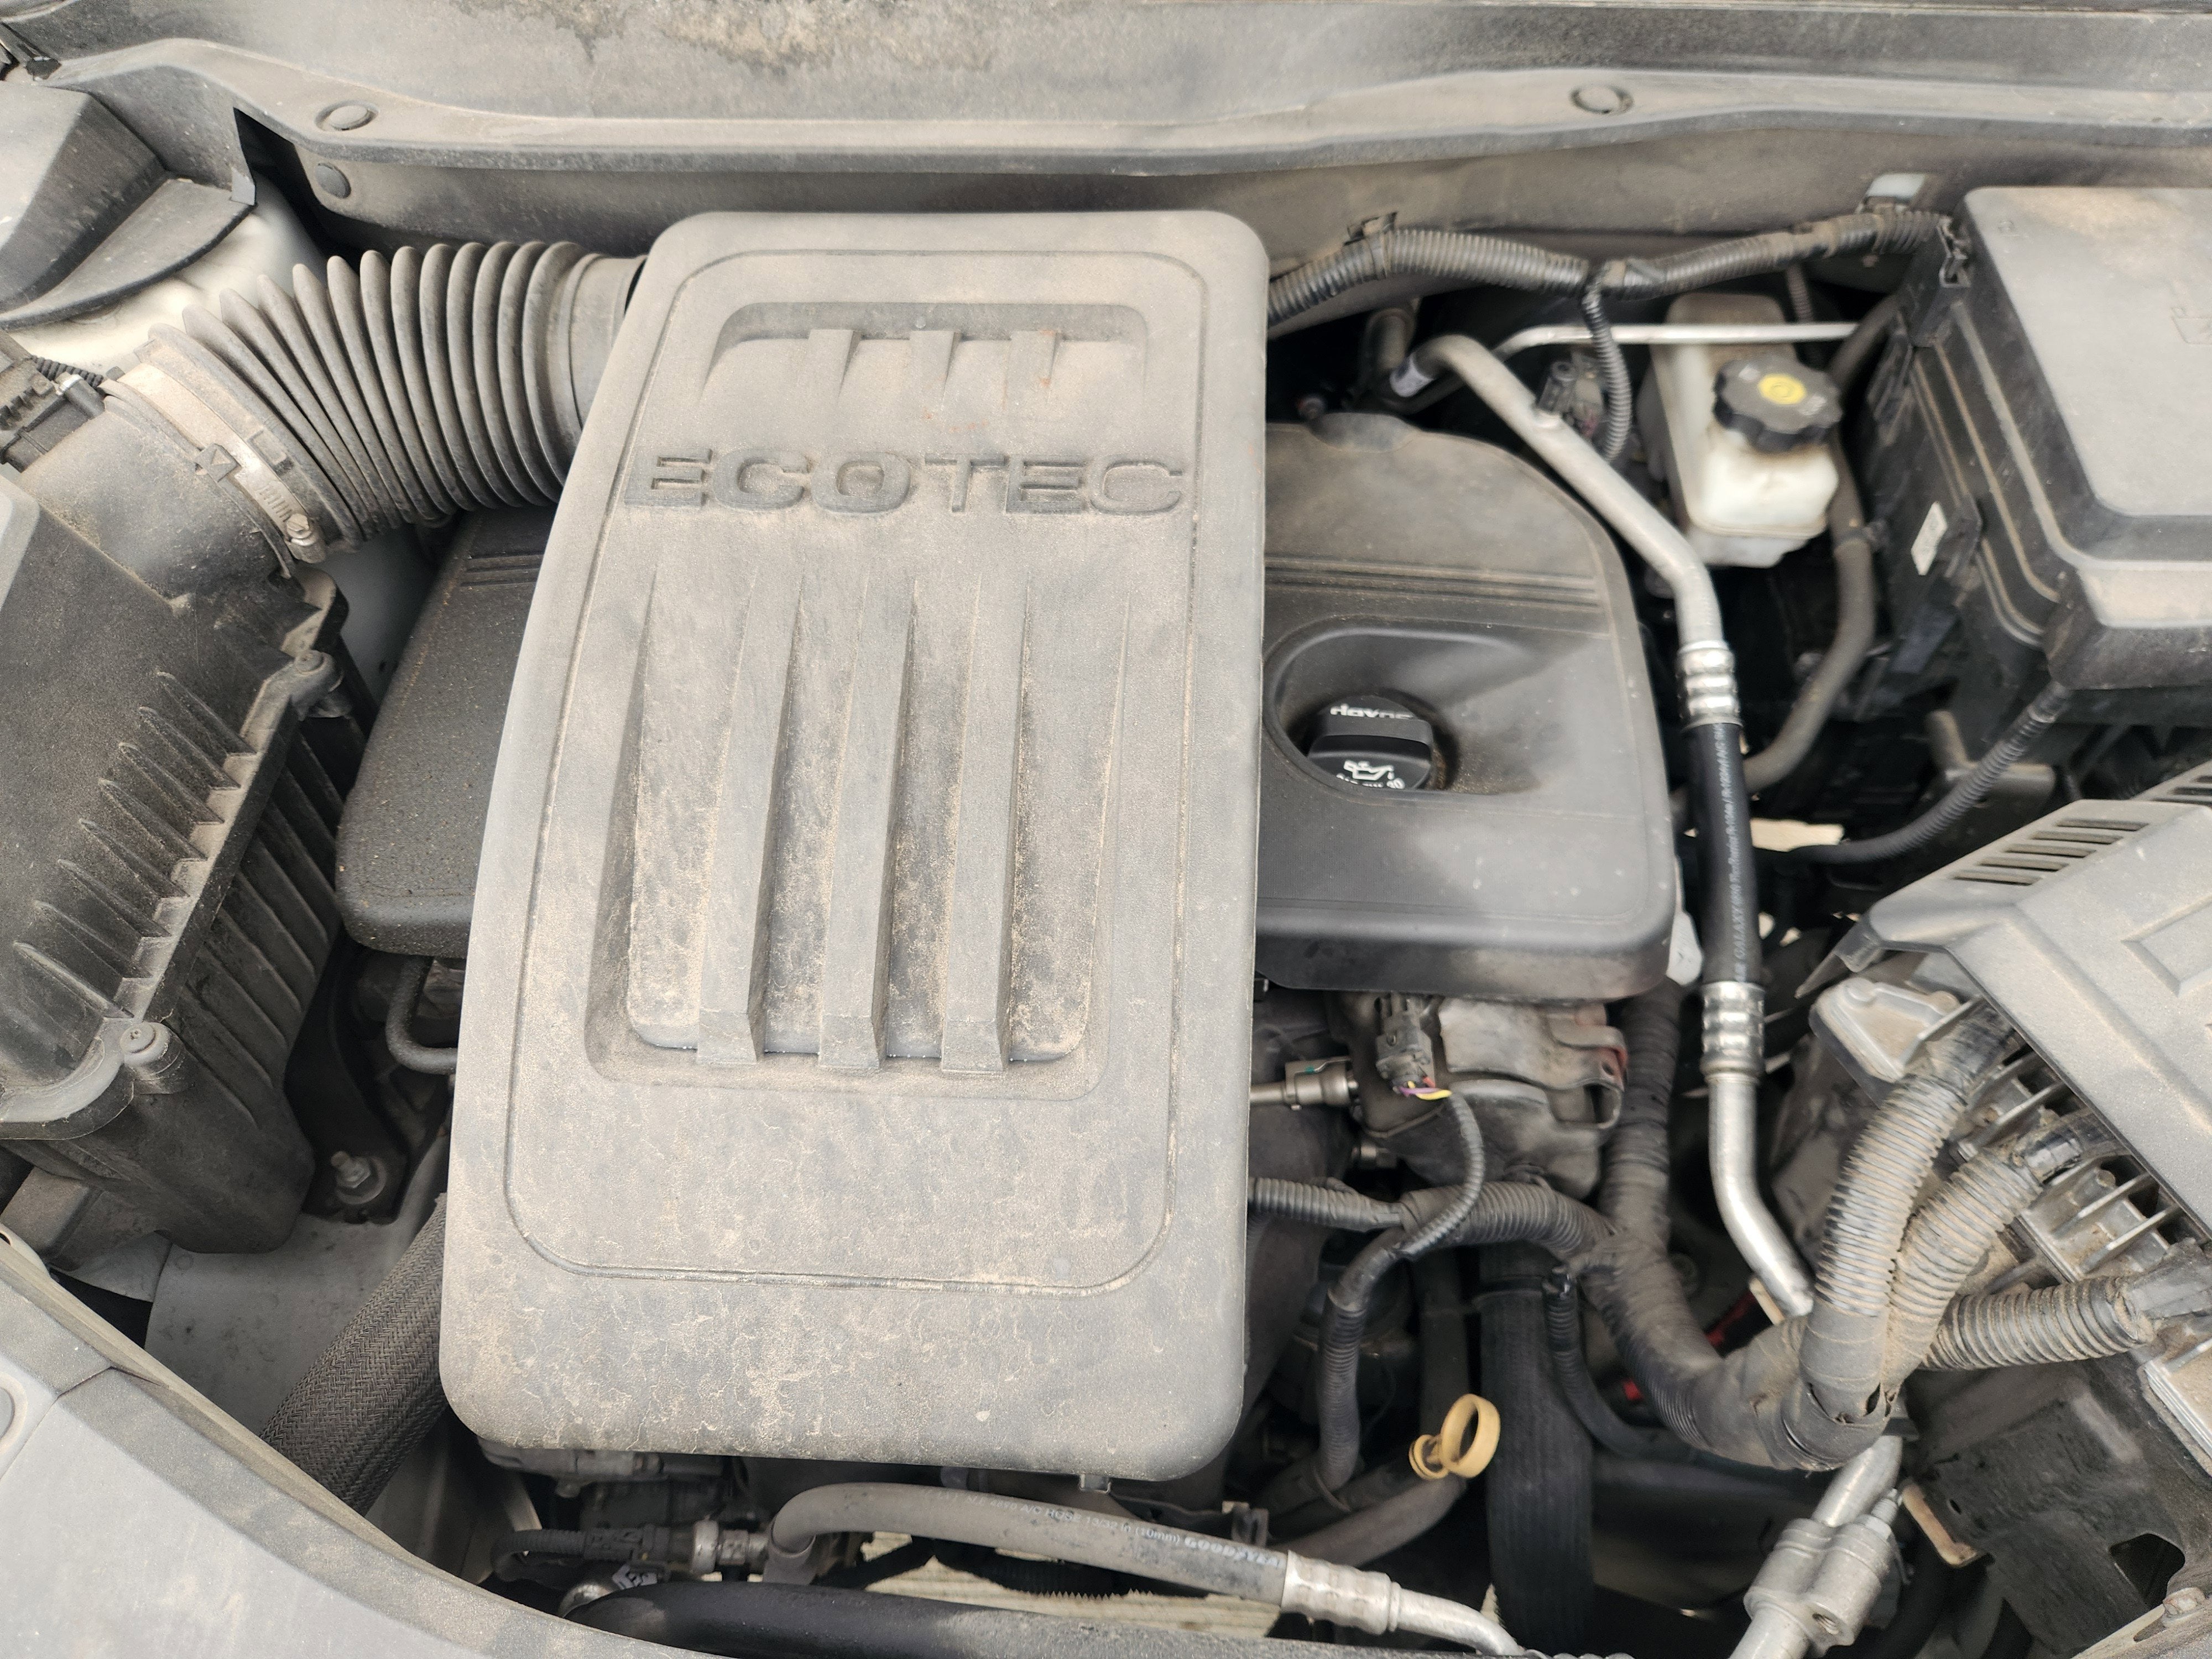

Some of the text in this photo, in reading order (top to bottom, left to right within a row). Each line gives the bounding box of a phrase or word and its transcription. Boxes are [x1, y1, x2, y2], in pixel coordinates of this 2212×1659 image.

[624, 447, 1183, 515] ECOTEC
[1046, 1509, 1082, 1522] HOSE
[1086, 1516, 1118, 1530] 13/32
